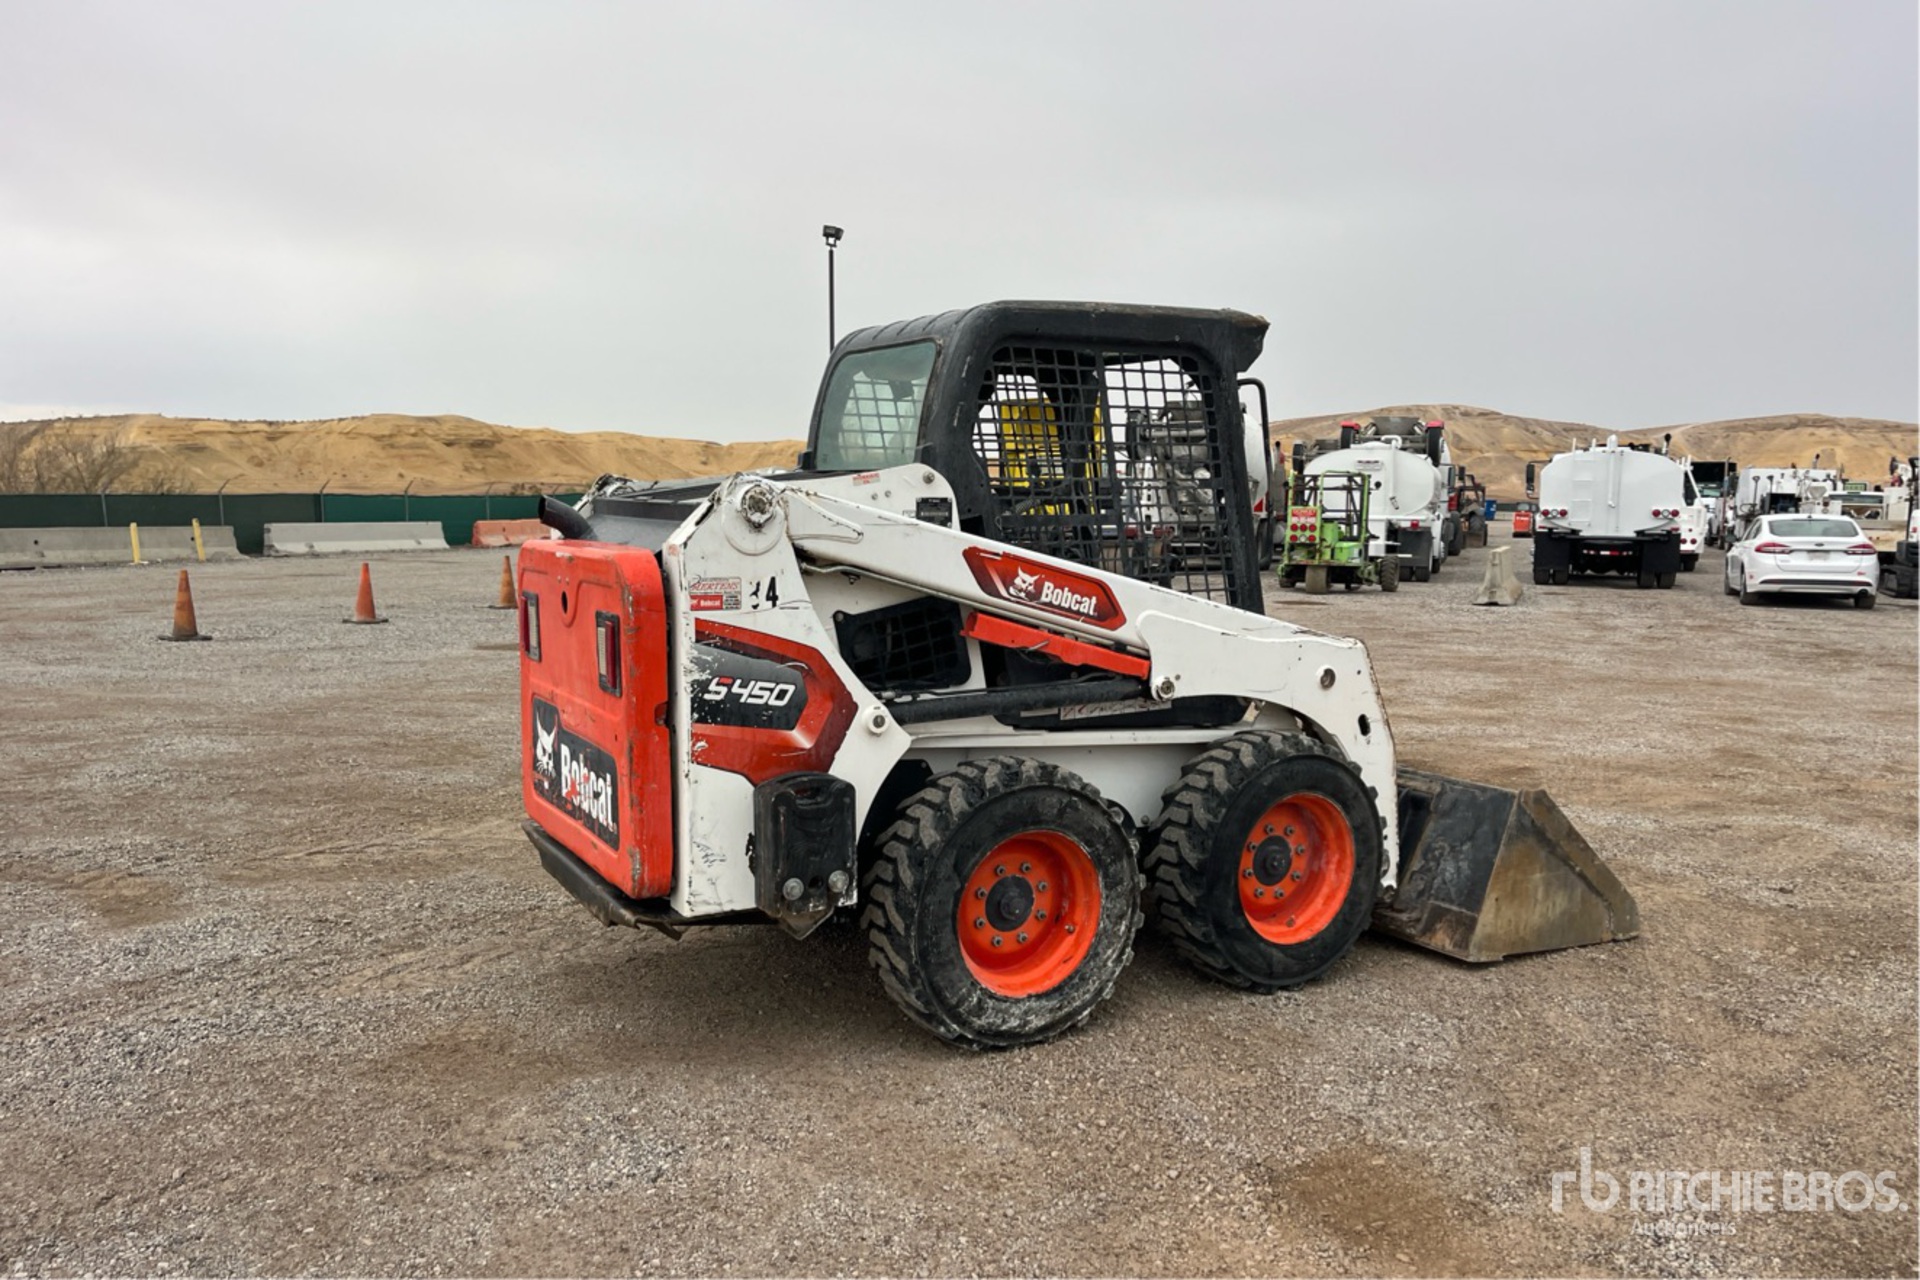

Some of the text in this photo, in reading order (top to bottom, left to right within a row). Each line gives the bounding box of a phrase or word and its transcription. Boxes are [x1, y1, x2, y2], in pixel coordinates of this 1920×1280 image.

[1041, 581, 1097, 616] Bobcat
[703, 676, 796, 707] S450
[560, 743, 614, 832] Bobcat
